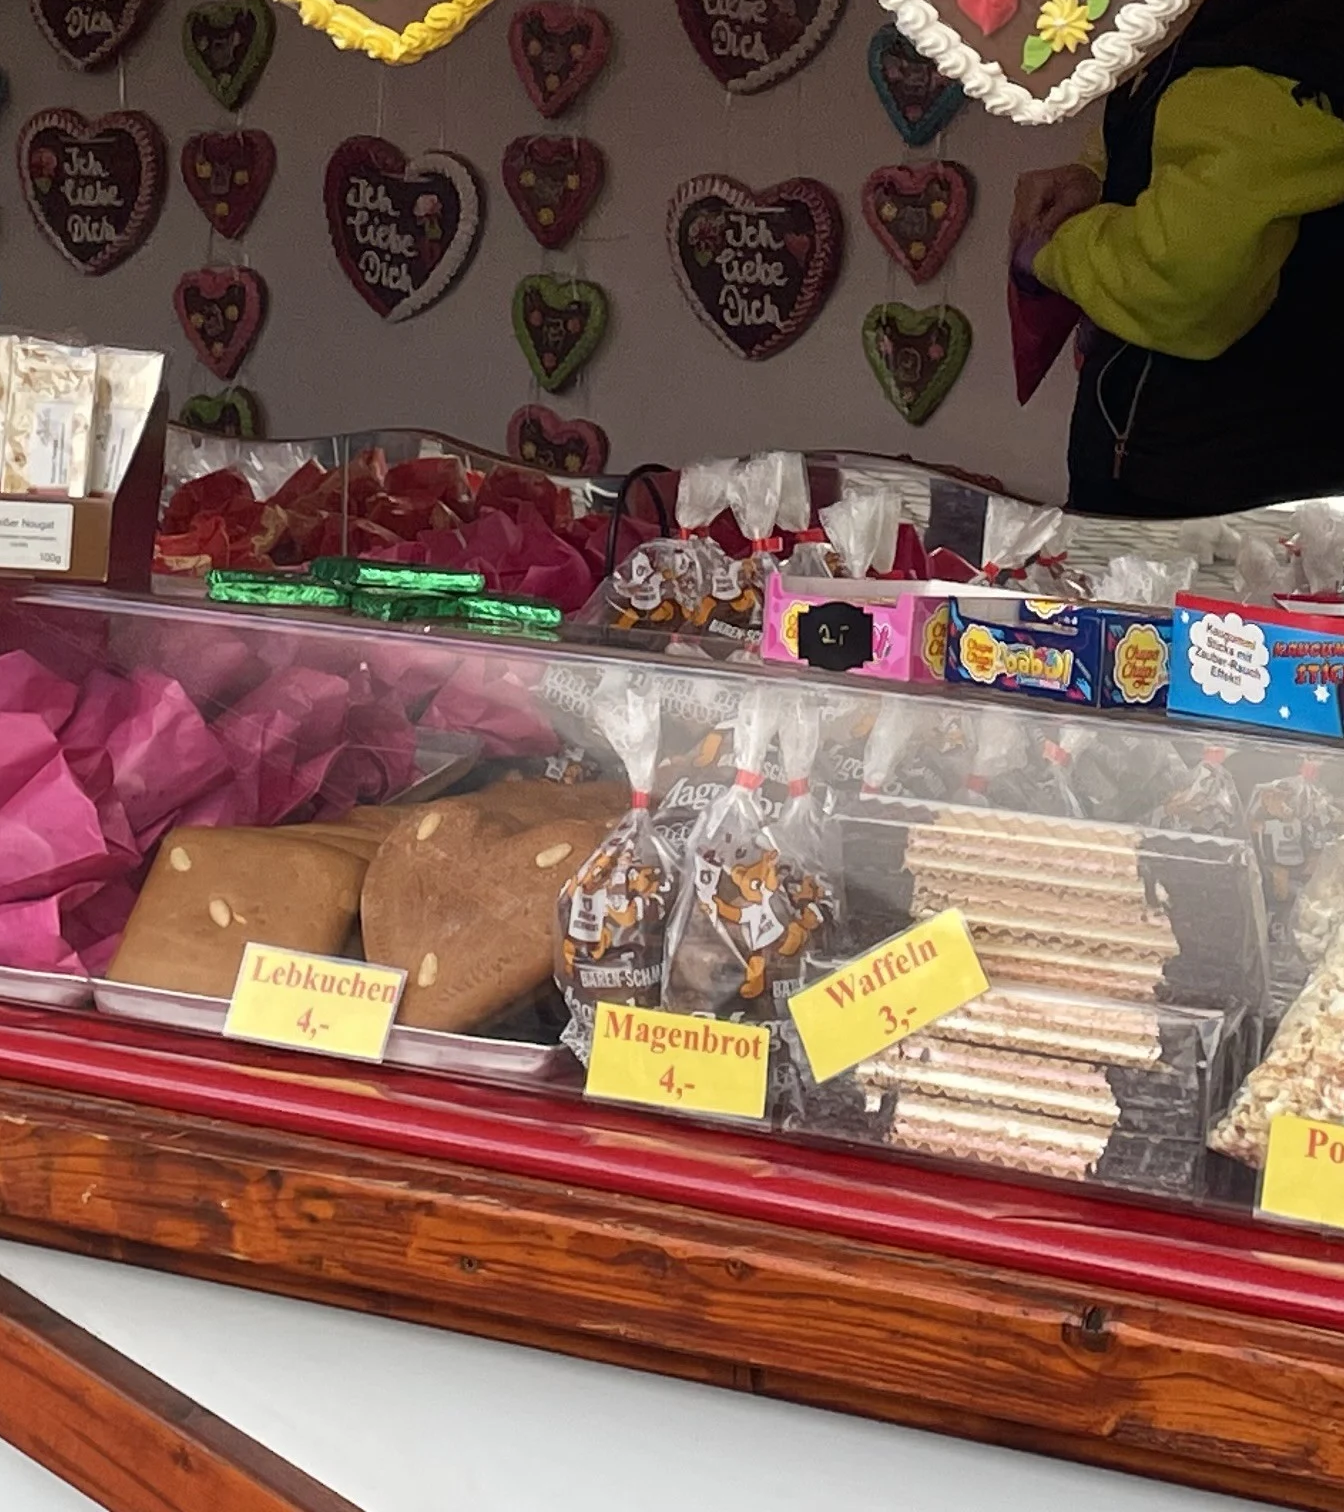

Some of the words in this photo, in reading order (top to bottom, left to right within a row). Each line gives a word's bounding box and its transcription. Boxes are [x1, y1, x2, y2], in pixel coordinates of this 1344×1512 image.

[65, 6, 117, 39] Dich
[710, 19, 769, 63] Dich
[347, 178, 400, 216] Ich
[67, 211, 122, 245] Dich
[724, 214, 784, 251] Ich
[357, 250, 414, 292] Dich
[719, 289, 788, 331] Dich
[1123, 644, 1160, 662] Chupa
[1207, 638, 1234, 656] Sticks
[1121, 660, 1159, 679] Chups
[250, 955, 398, 1006] Lebkuchen
[824, 932, 939, 1011] Waffeln
[295, 1006, 331, 1041] 4,-
[603, 1010, 764, 1061] Magenbrot
[878, 1001, 918, 1038] 3,-
[658, 1064, 696, 1100] 4,-
